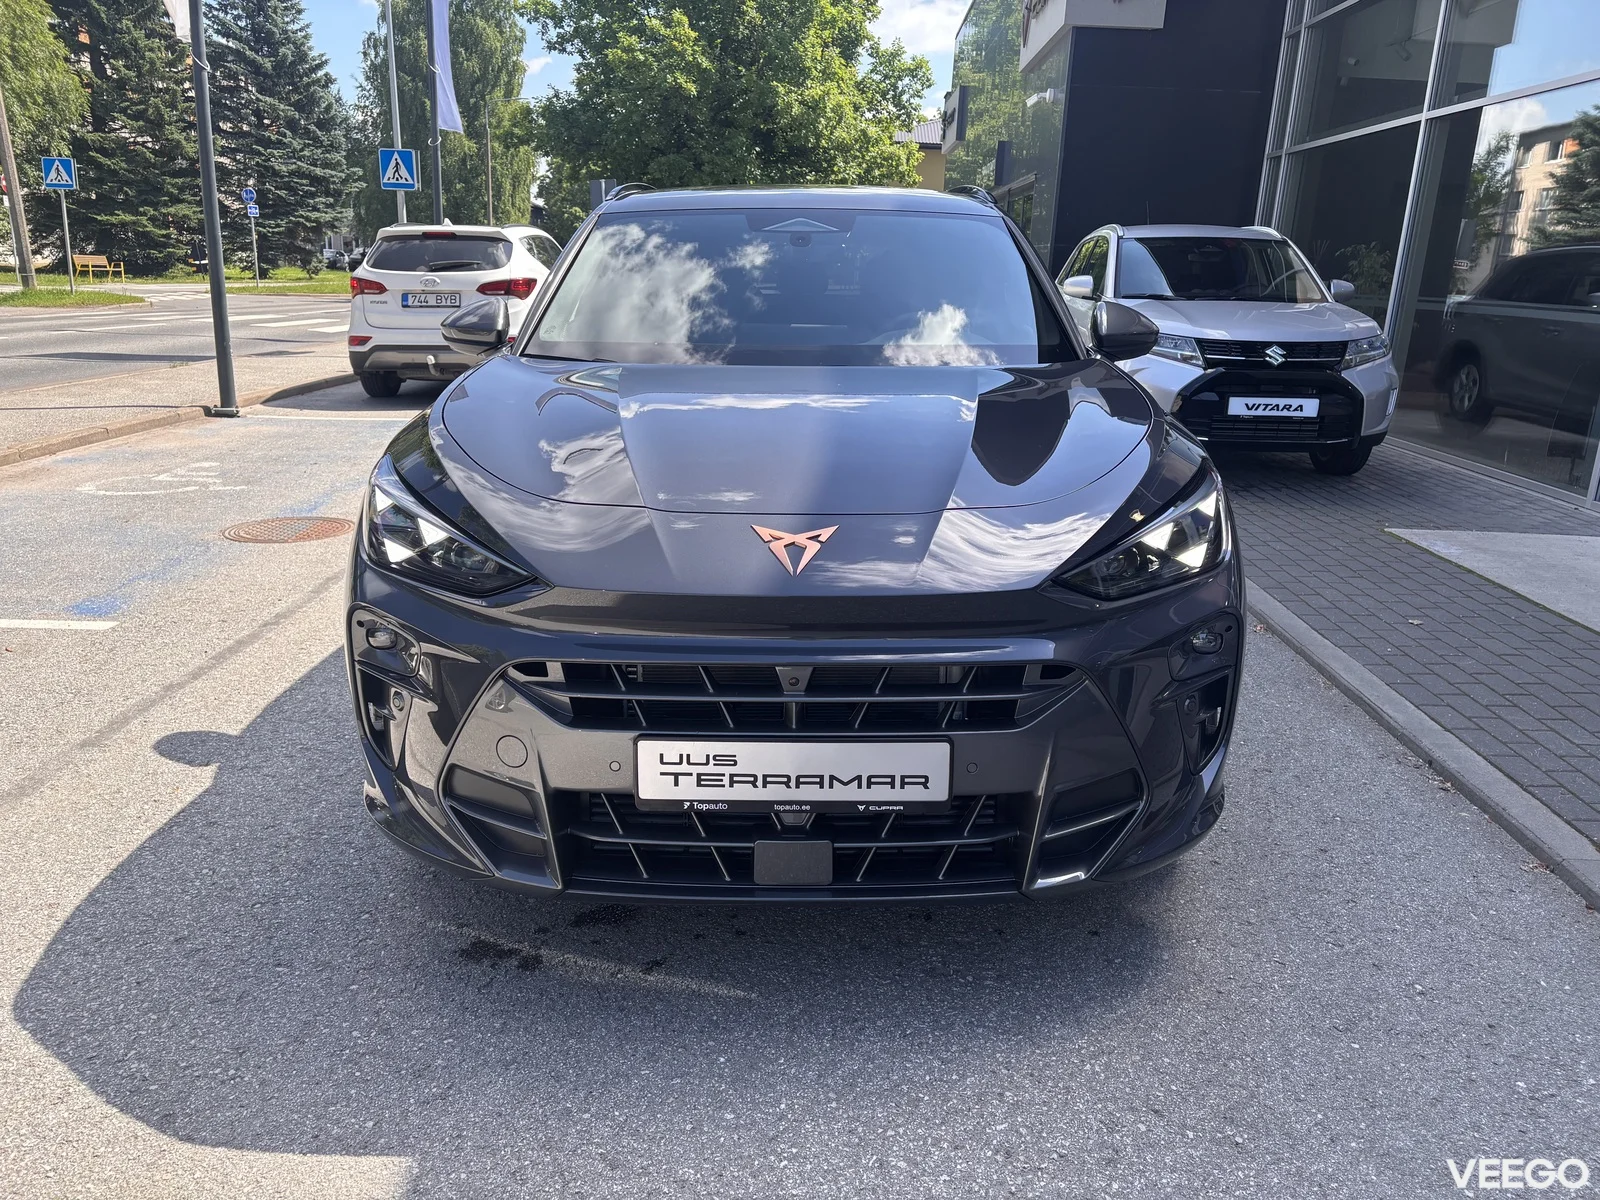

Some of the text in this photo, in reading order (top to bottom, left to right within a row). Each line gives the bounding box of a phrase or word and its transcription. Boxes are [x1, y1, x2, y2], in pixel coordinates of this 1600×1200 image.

[411, 295, 428, 304] 744
[436, 295, 457, 304] BYB
[1244, 403, 1304, 413] VITARA
[659, 753, 738, 767] UUS
[659, 772, 930, 790] TERRAMAR
[692, 802, 728, 811] Topauto
